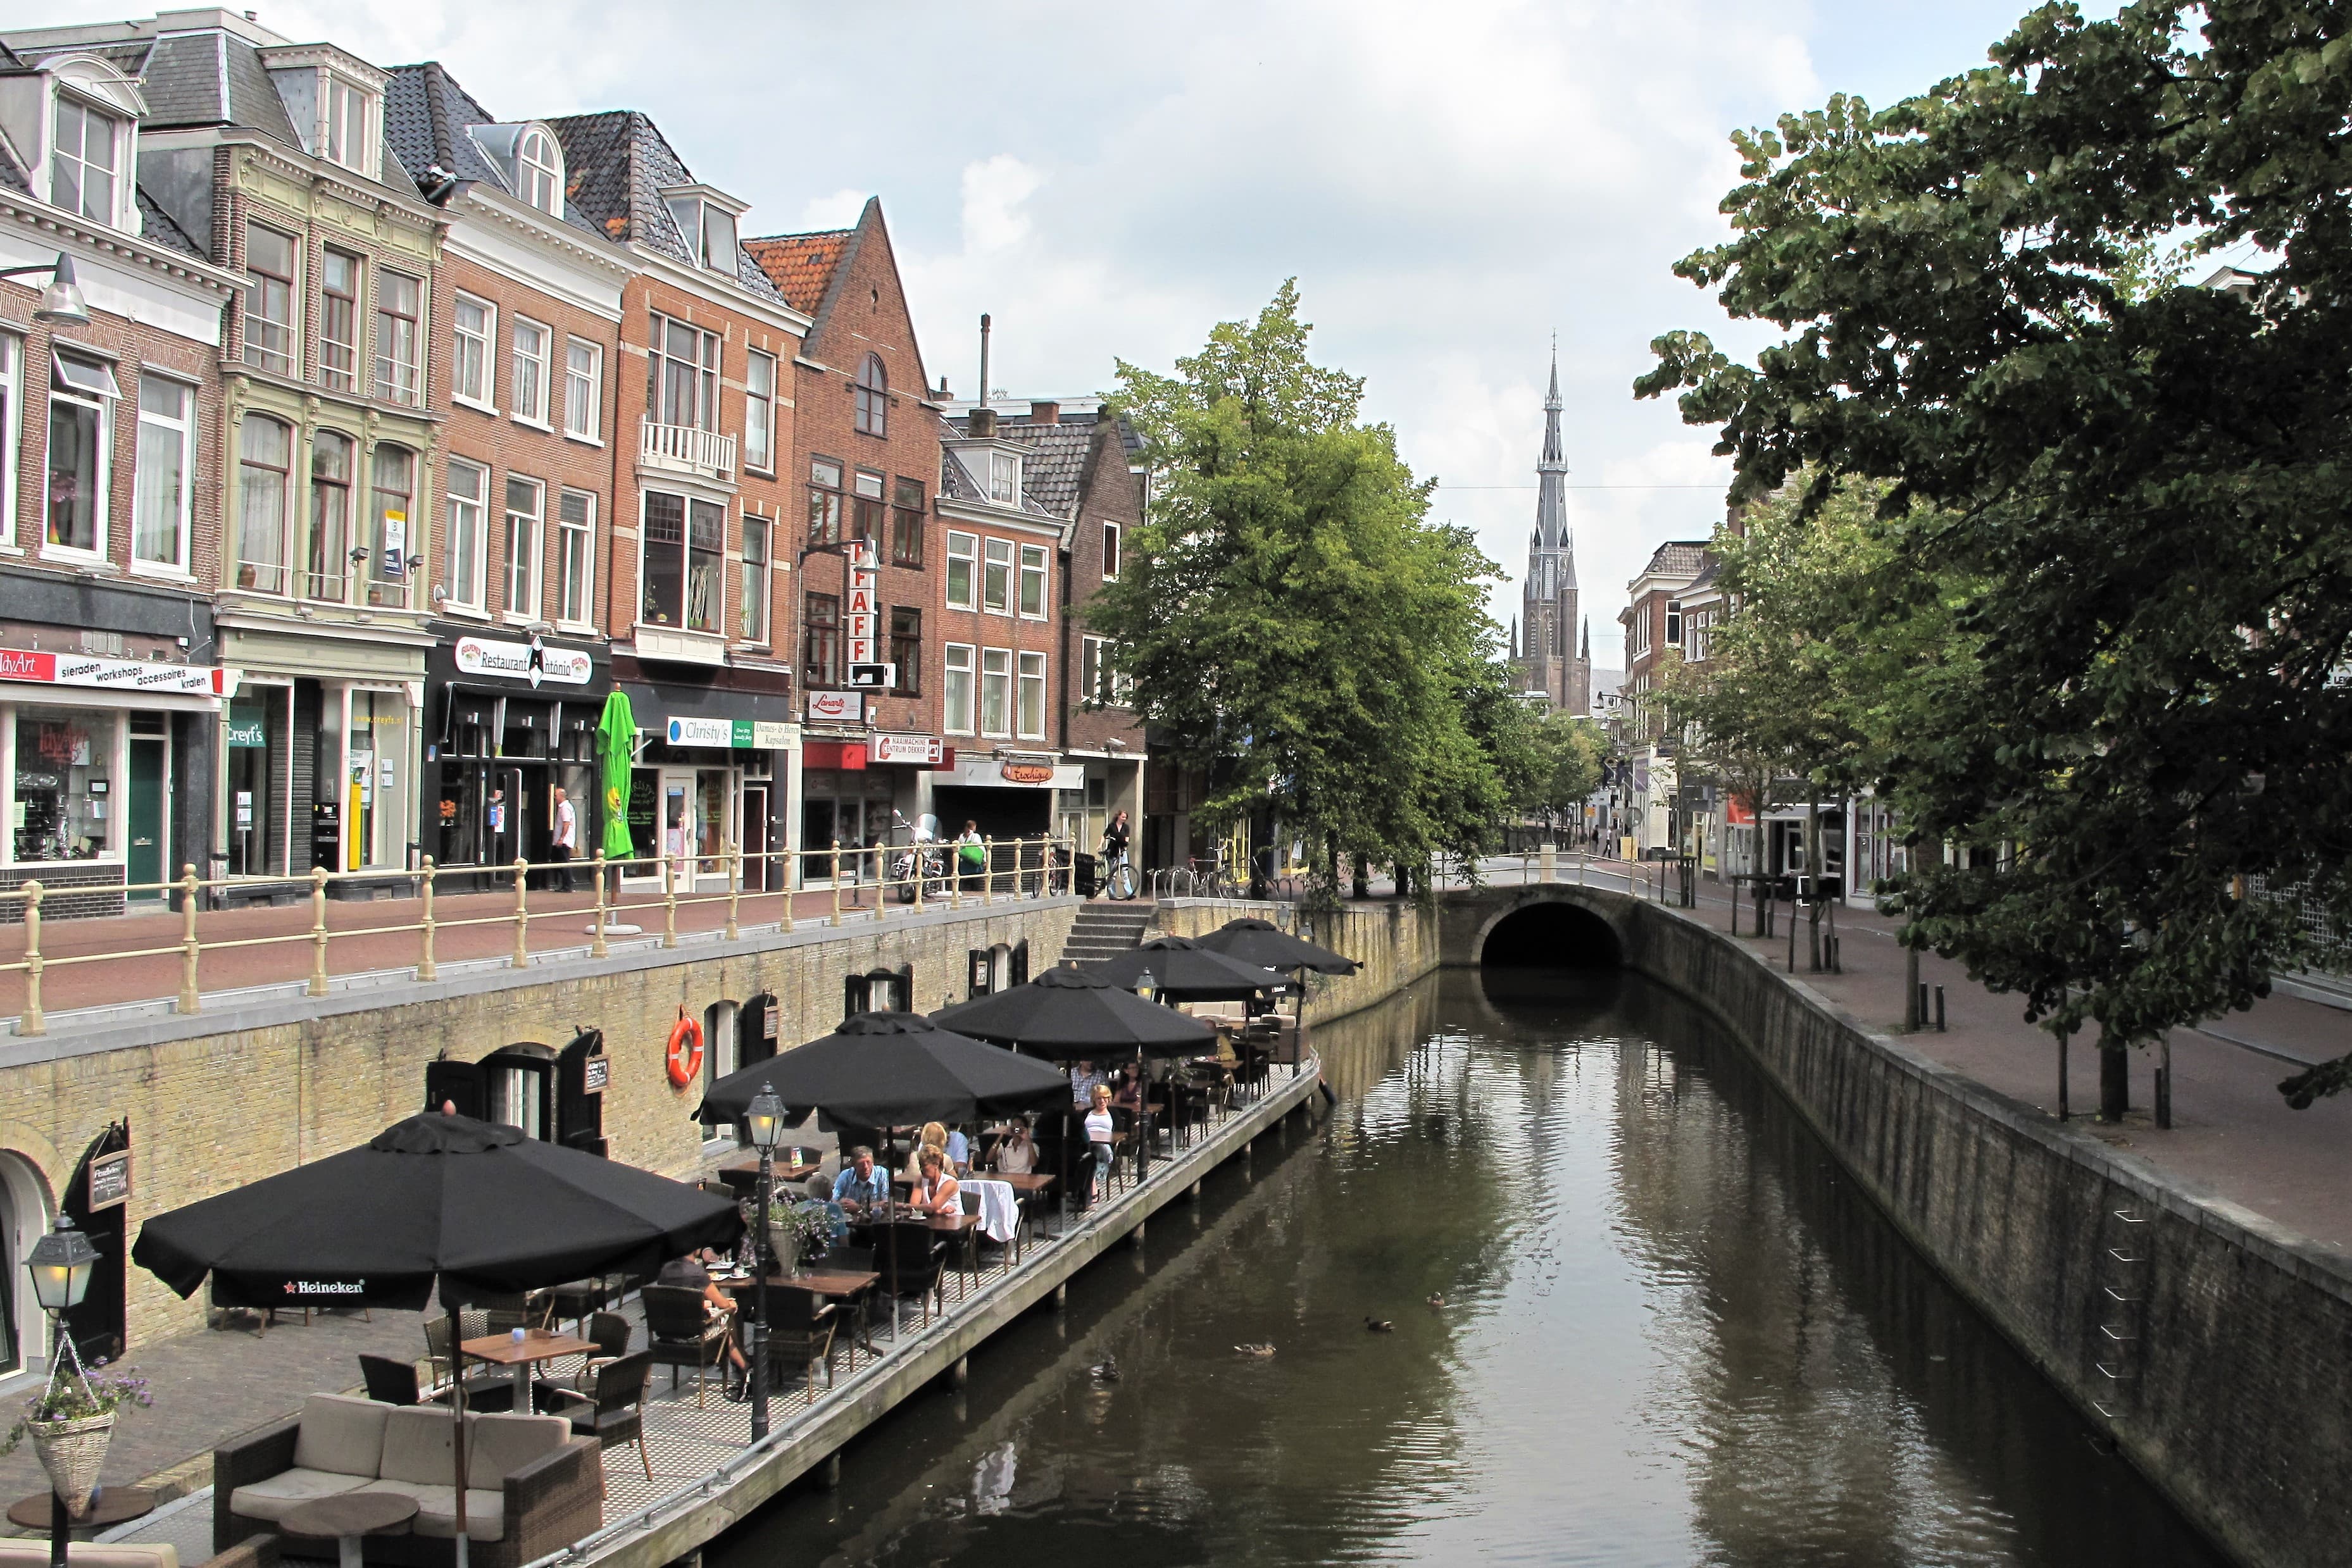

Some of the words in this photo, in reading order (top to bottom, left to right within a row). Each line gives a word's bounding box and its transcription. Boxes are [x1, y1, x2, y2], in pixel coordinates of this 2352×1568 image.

[482, 651, 527, 671] Restaurant
[61, 663, 101, 678] sieraden
[96, 666, 143, 682] workshops
[137, 669, 186, 685] accessoires
[181, 676, 206, 689] kralen
[756, 723, 777, 733] Dames-
[778, 725, 783, 733] &
[784, 725, 799, 734] Heren
[765, 735, 791, 746] Kapsalon
[892, 737, 926, 745] NAAIMACHINE
[297, 1281, 364, 1293] Heineken
